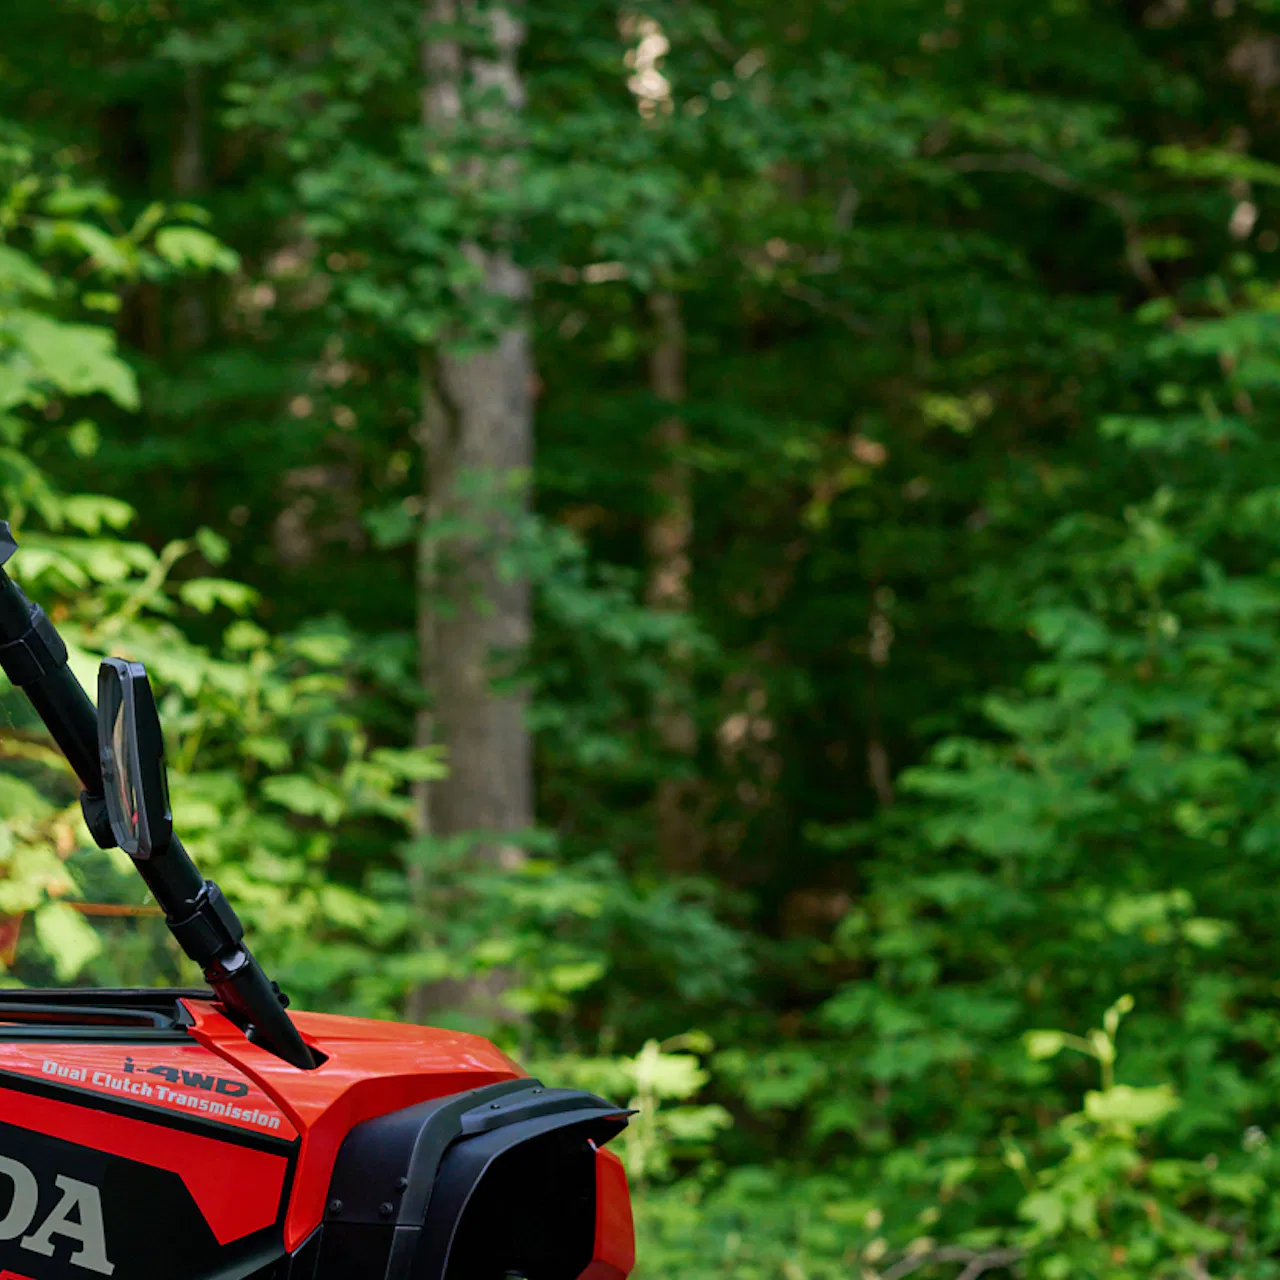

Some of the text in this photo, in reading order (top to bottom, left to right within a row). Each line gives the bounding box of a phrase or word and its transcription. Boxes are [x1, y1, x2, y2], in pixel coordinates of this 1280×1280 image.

[42, 1060, 280, 1129] Dual Clutch Transmission
[124, 1057, 248, 1097] i-4WD
